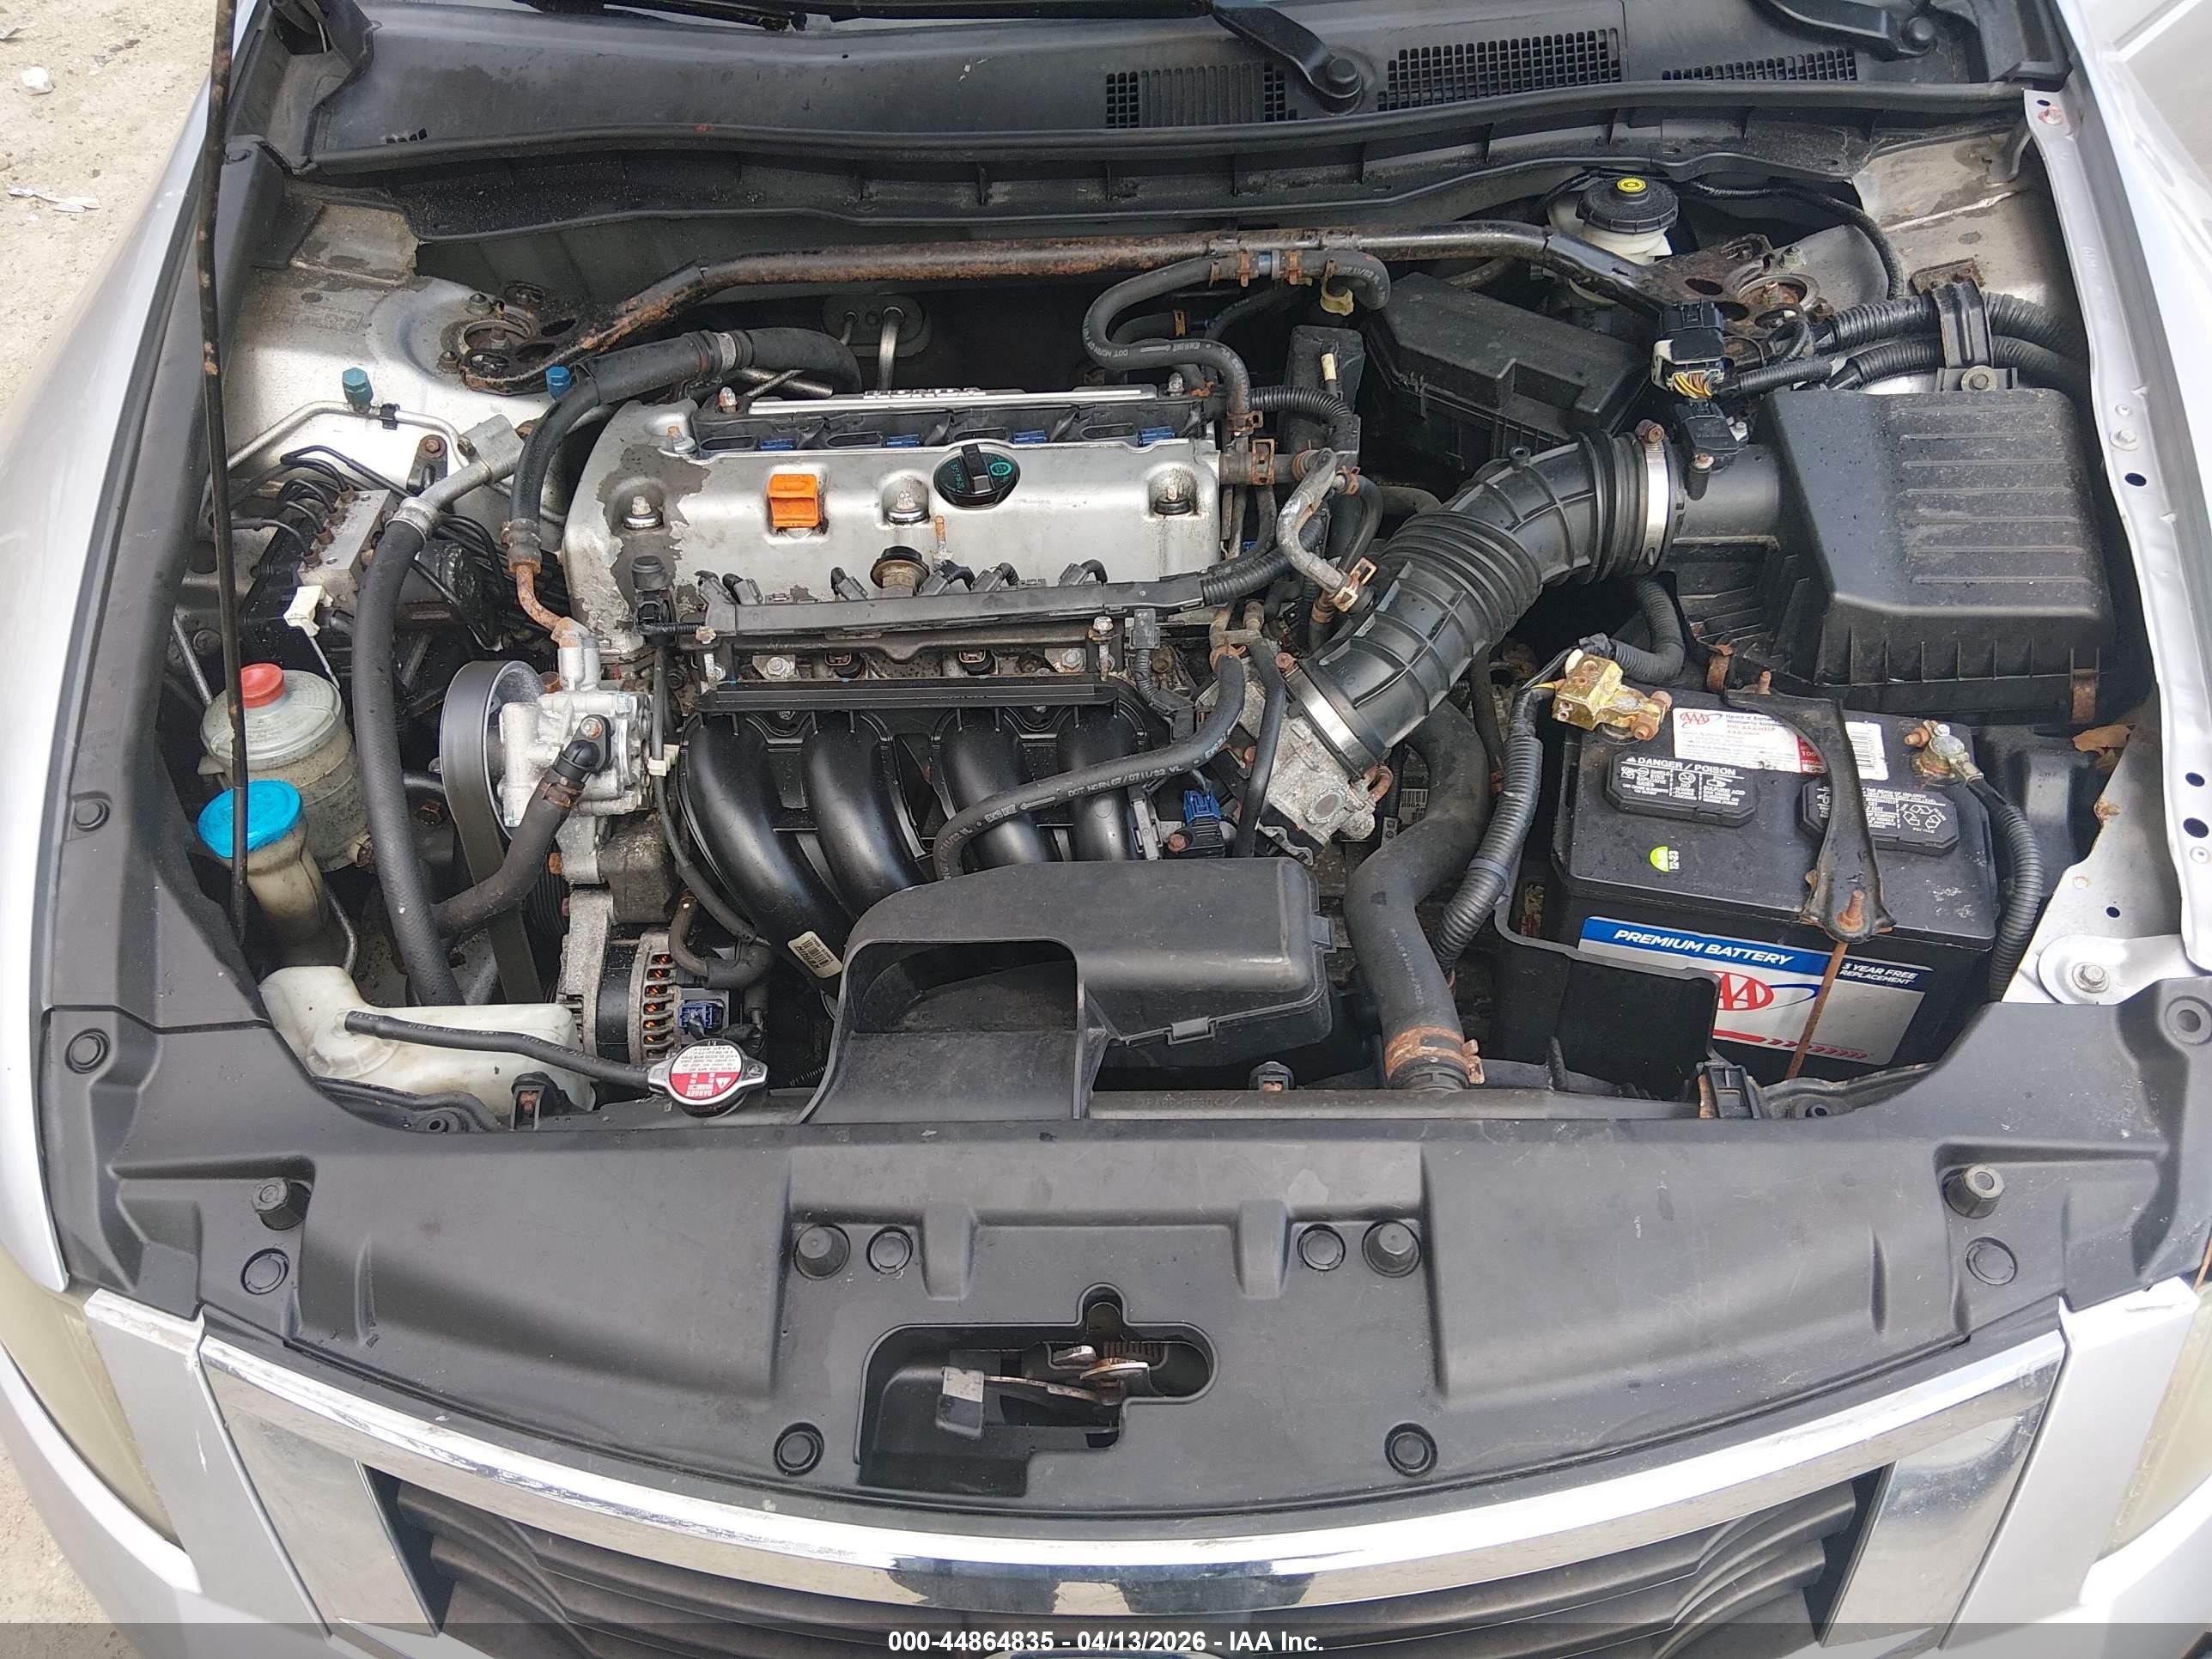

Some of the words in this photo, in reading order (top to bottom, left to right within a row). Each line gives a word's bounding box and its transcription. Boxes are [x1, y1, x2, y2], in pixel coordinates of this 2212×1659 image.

[1683, 712, 1708, 725] AAA
[1638, 757, 1684, 769] DANGER
[1694, 764, 1736, 776] POISON
[1613, 929, 1705, 953] PREMIUM
[1705, 944, 1795, 965] BATTERY
[1852, 964, 1884, 975] YEAR
[1885, 969, 1918, 980] FREE
